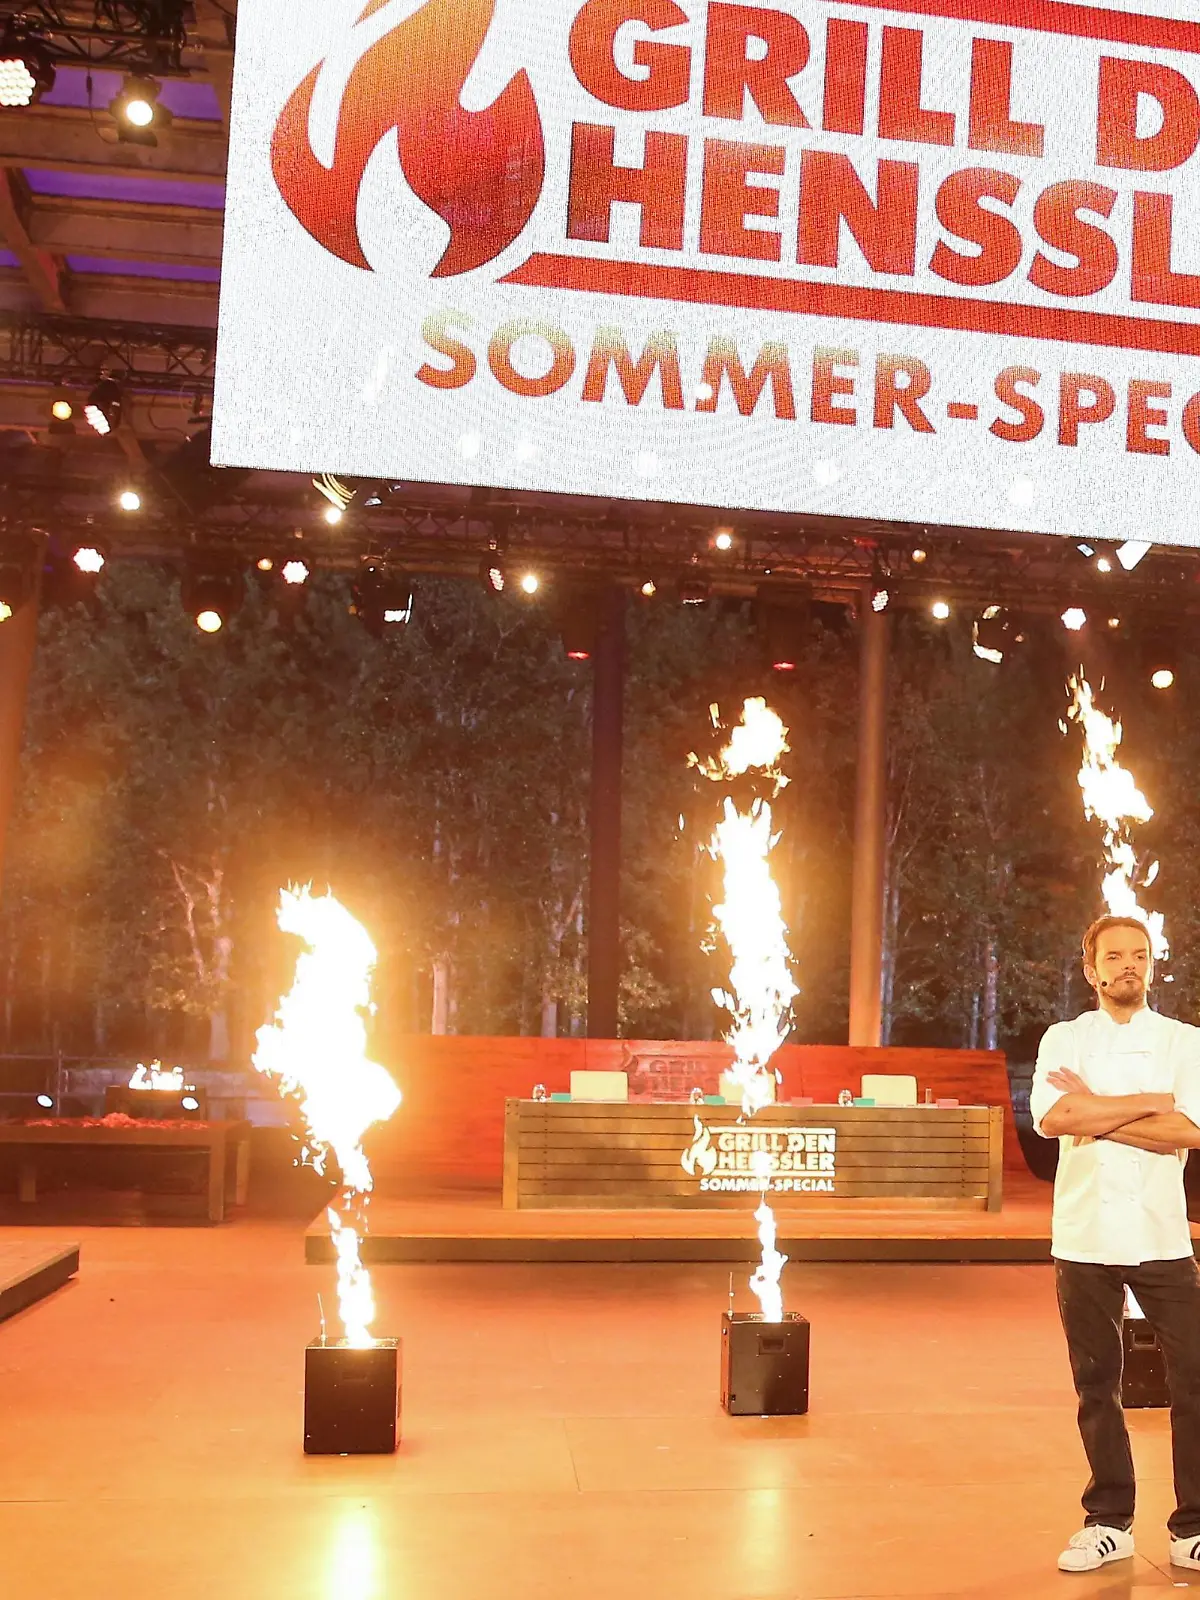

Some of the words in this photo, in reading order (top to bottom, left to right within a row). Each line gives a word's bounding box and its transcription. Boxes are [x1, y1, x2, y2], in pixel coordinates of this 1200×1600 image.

[569, 0, 1044, 158] GRILL
[566, 121, 1200, 309] HENSSL
[414, 309, 1200, 456] SOMMER-SPE
[718, 1133, 783, 1151] GRILL
[787, 1133, 836, 1152] DEN
[718, 1152, 836, 1170] HESSLER
